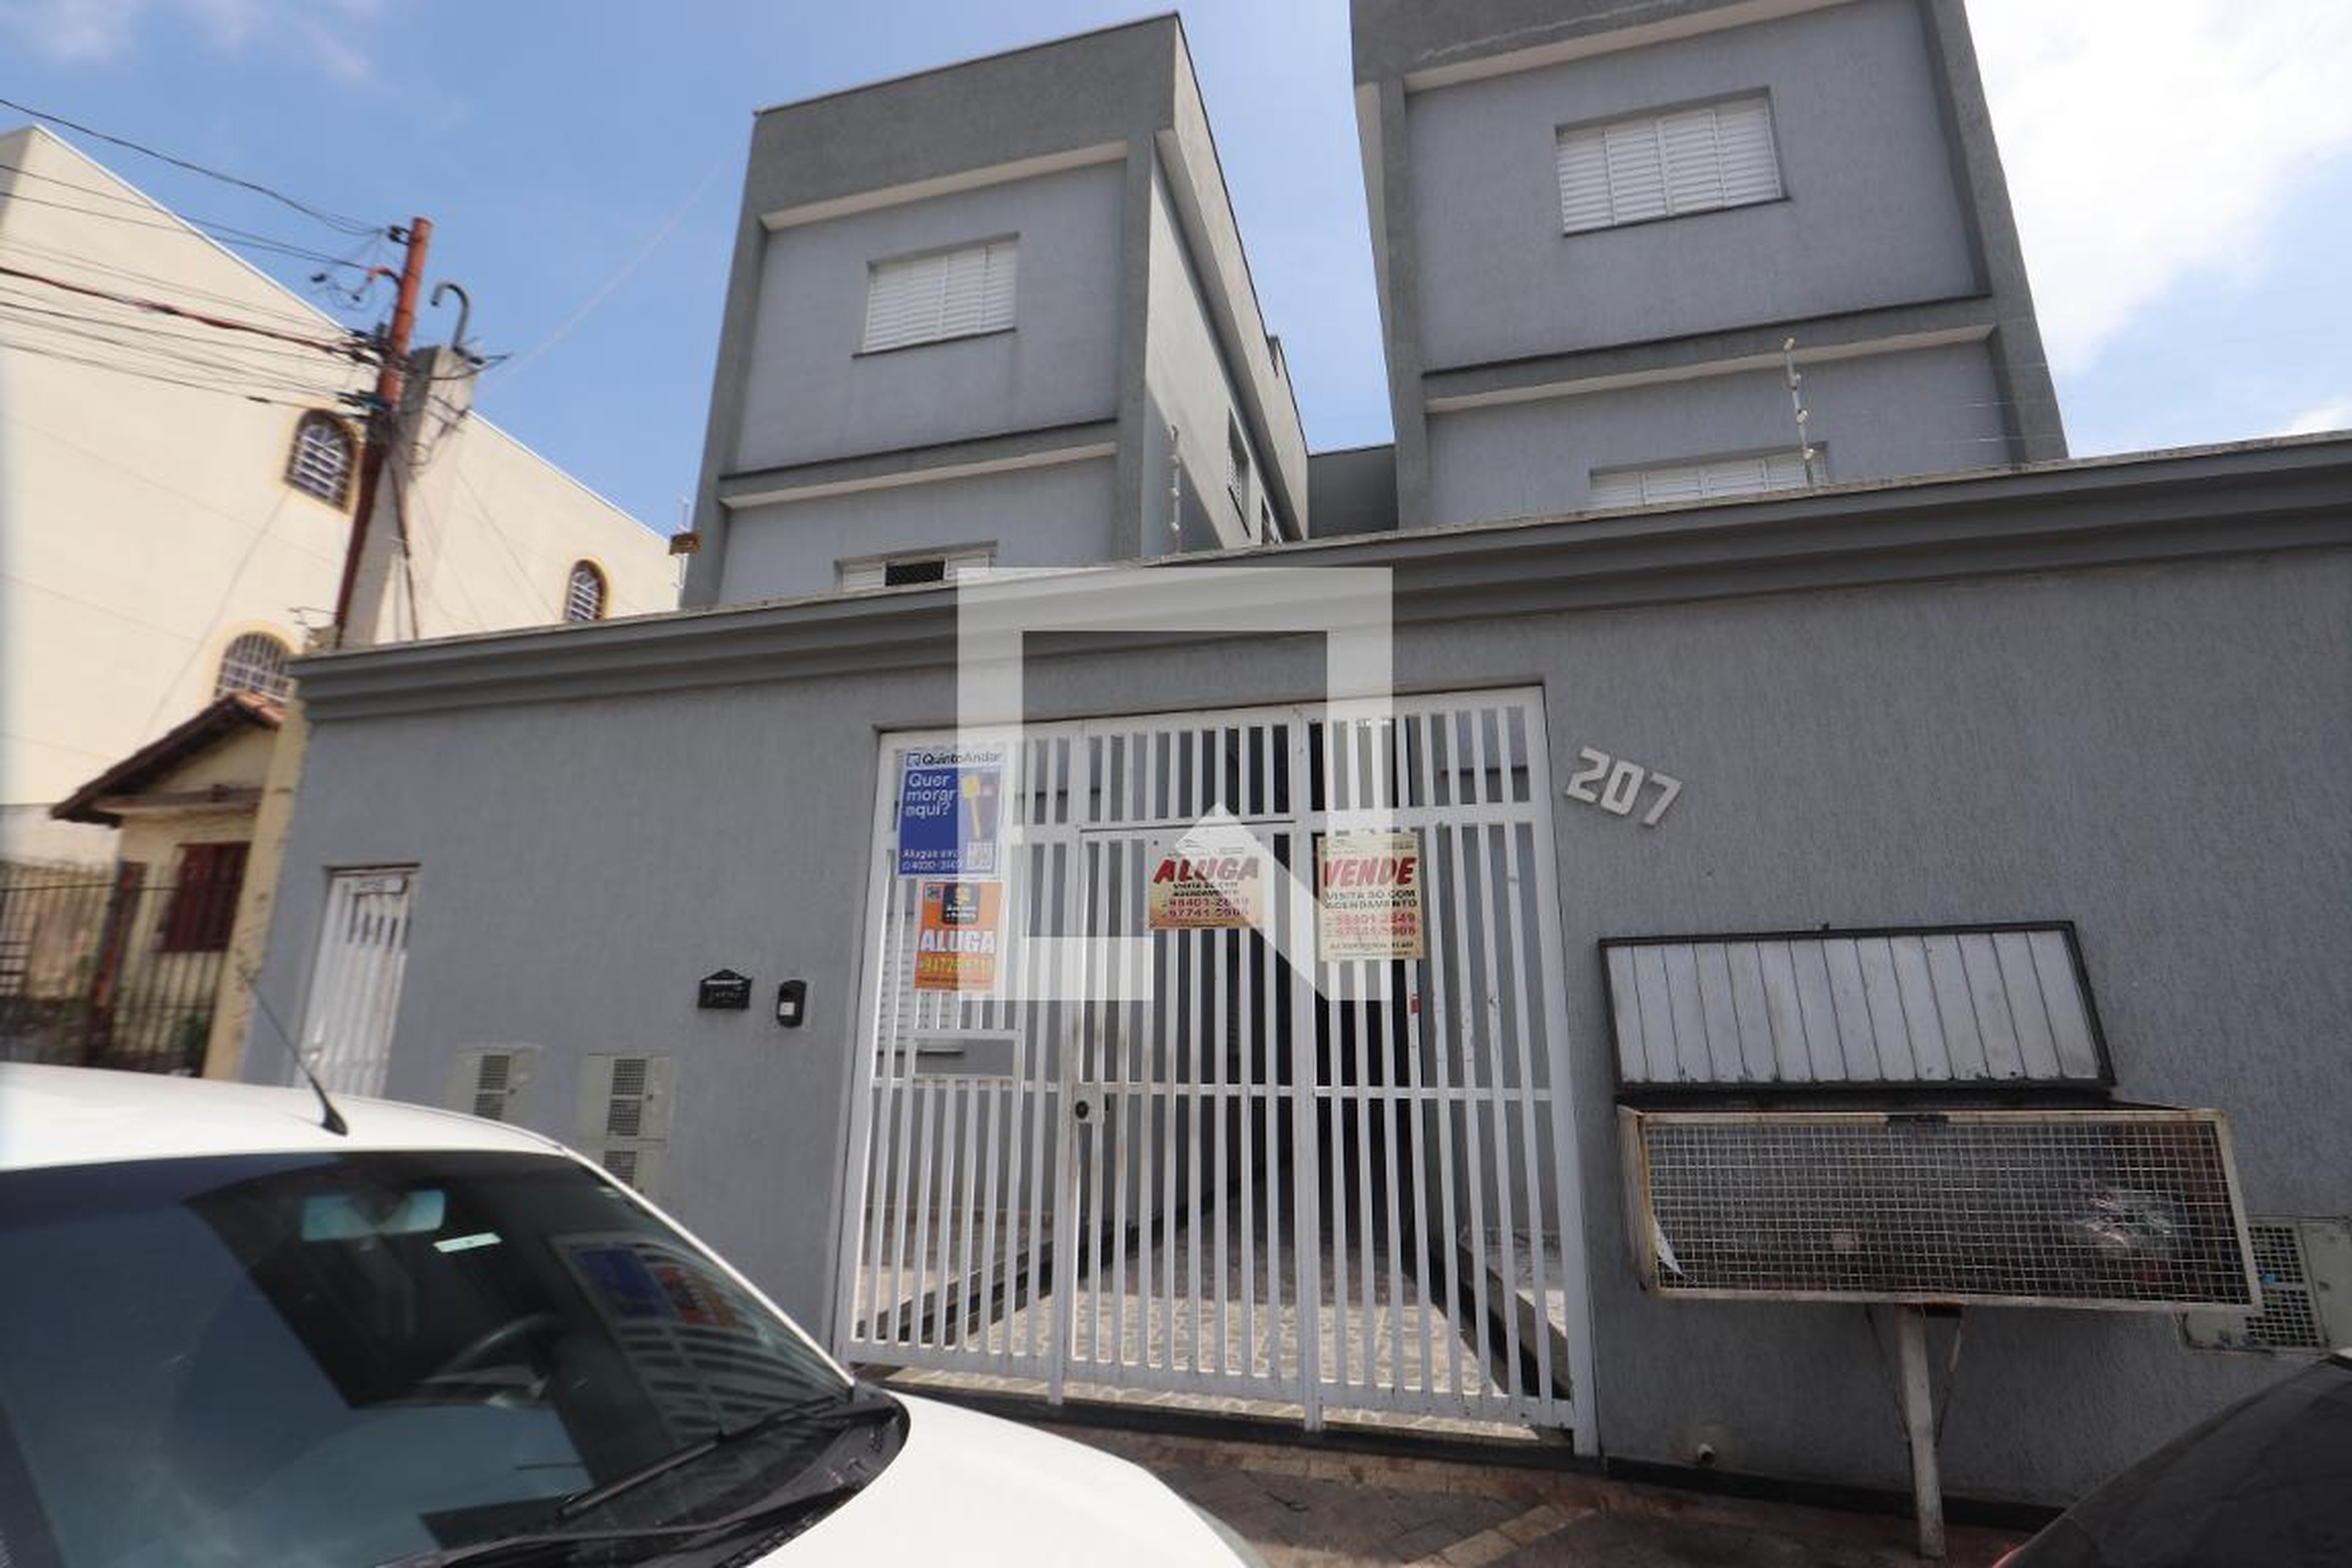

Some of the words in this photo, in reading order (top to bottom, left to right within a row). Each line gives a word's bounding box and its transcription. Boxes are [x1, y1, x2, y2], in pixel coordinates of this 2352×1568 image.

[922, 750, 1000, 766] QuintoAndar
[909, 773, 951, 787] Quer
[1566, 746, 1683, 826] 207
[907, 790, 957, 801] morar
[905, 801, 950, 819] aqui?
[1153, 857, 1259, 884] ALUGA
[1324, 856, 1417, 887] VENDE
[1326, 891, 1365, 901] VISITA
[1389, 889, 1416, 899] COM
[1325, 899, 1417, 909] AGENDAMENTO
[921, 929, 995, 954] ALUGA
